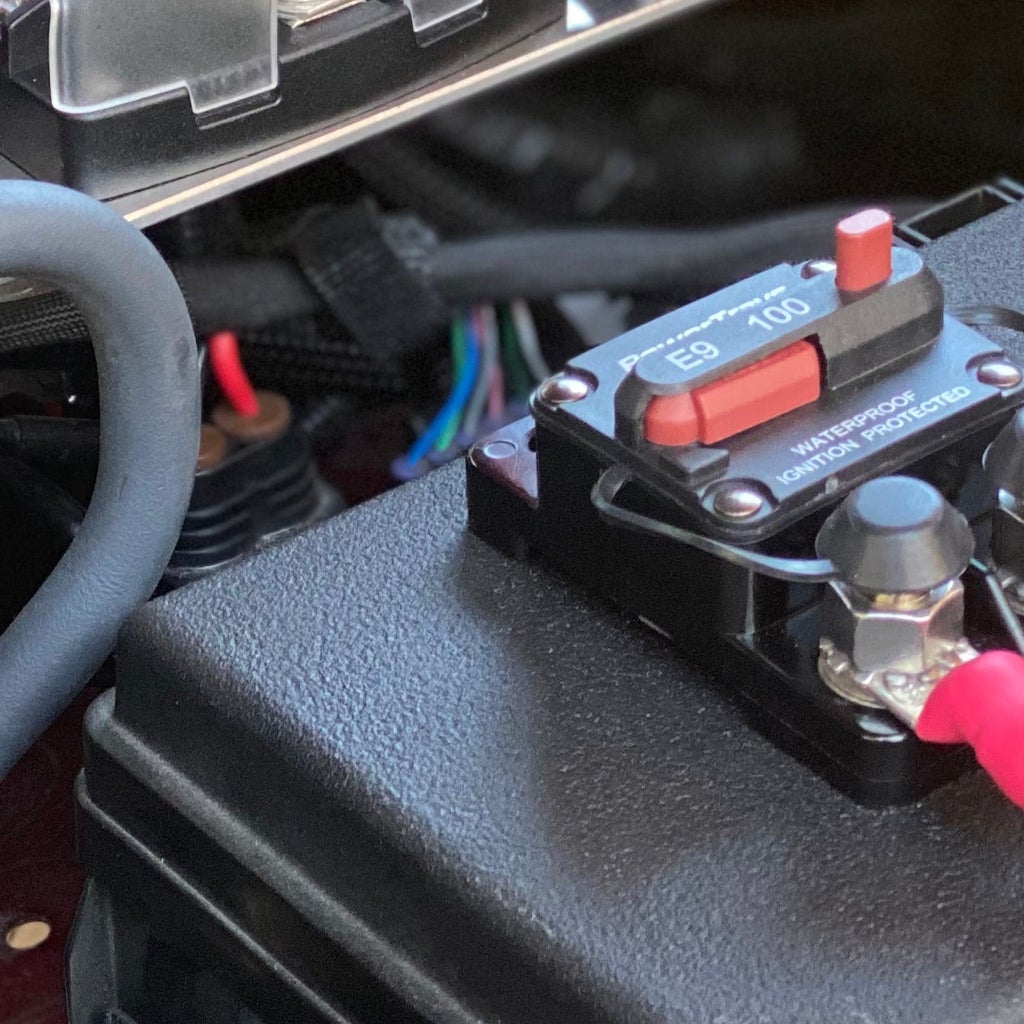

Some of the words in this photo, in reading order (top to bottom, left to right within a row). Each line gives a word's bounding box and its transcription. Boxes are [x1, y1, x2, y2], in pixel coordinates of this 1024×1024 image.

[665, 341, 719, 371] E9
[747, 297, 811, 331] 100
[776, 438, 861, 485] IGNITION
[860, 385, 971, 442] PROTECTED
[790, 389, 917, 456] WATERPROOF
